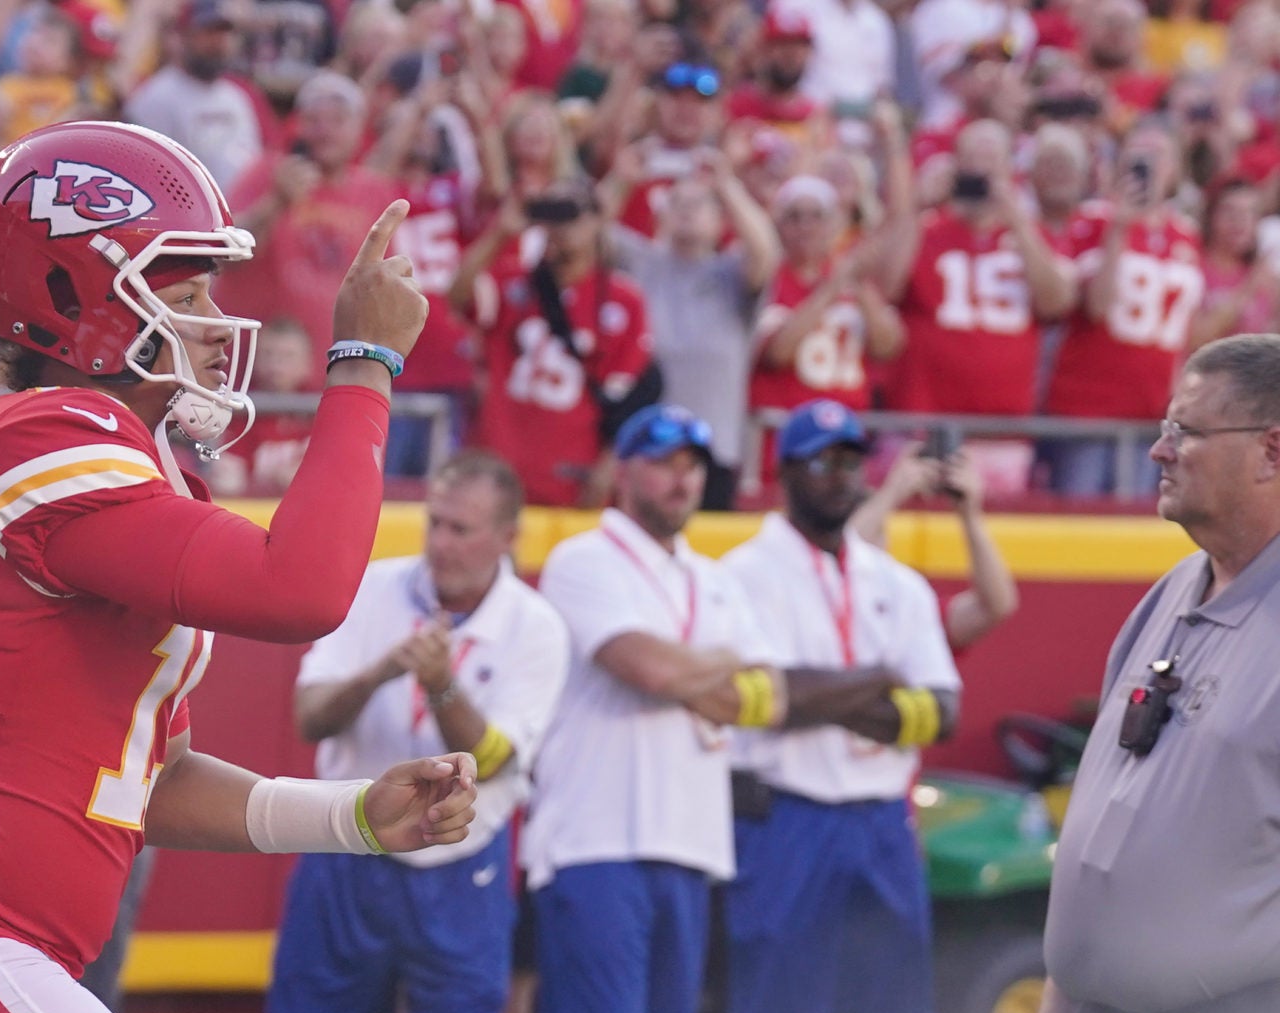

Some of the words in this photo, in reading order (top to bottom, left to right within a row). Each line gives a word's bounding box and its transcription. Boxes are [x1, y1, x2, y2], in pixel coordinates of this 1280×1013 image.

[53, 175, 134, 221] KC
[935, 250, 1031, 333] 15
[1108, 253, 1205, 350] 87
